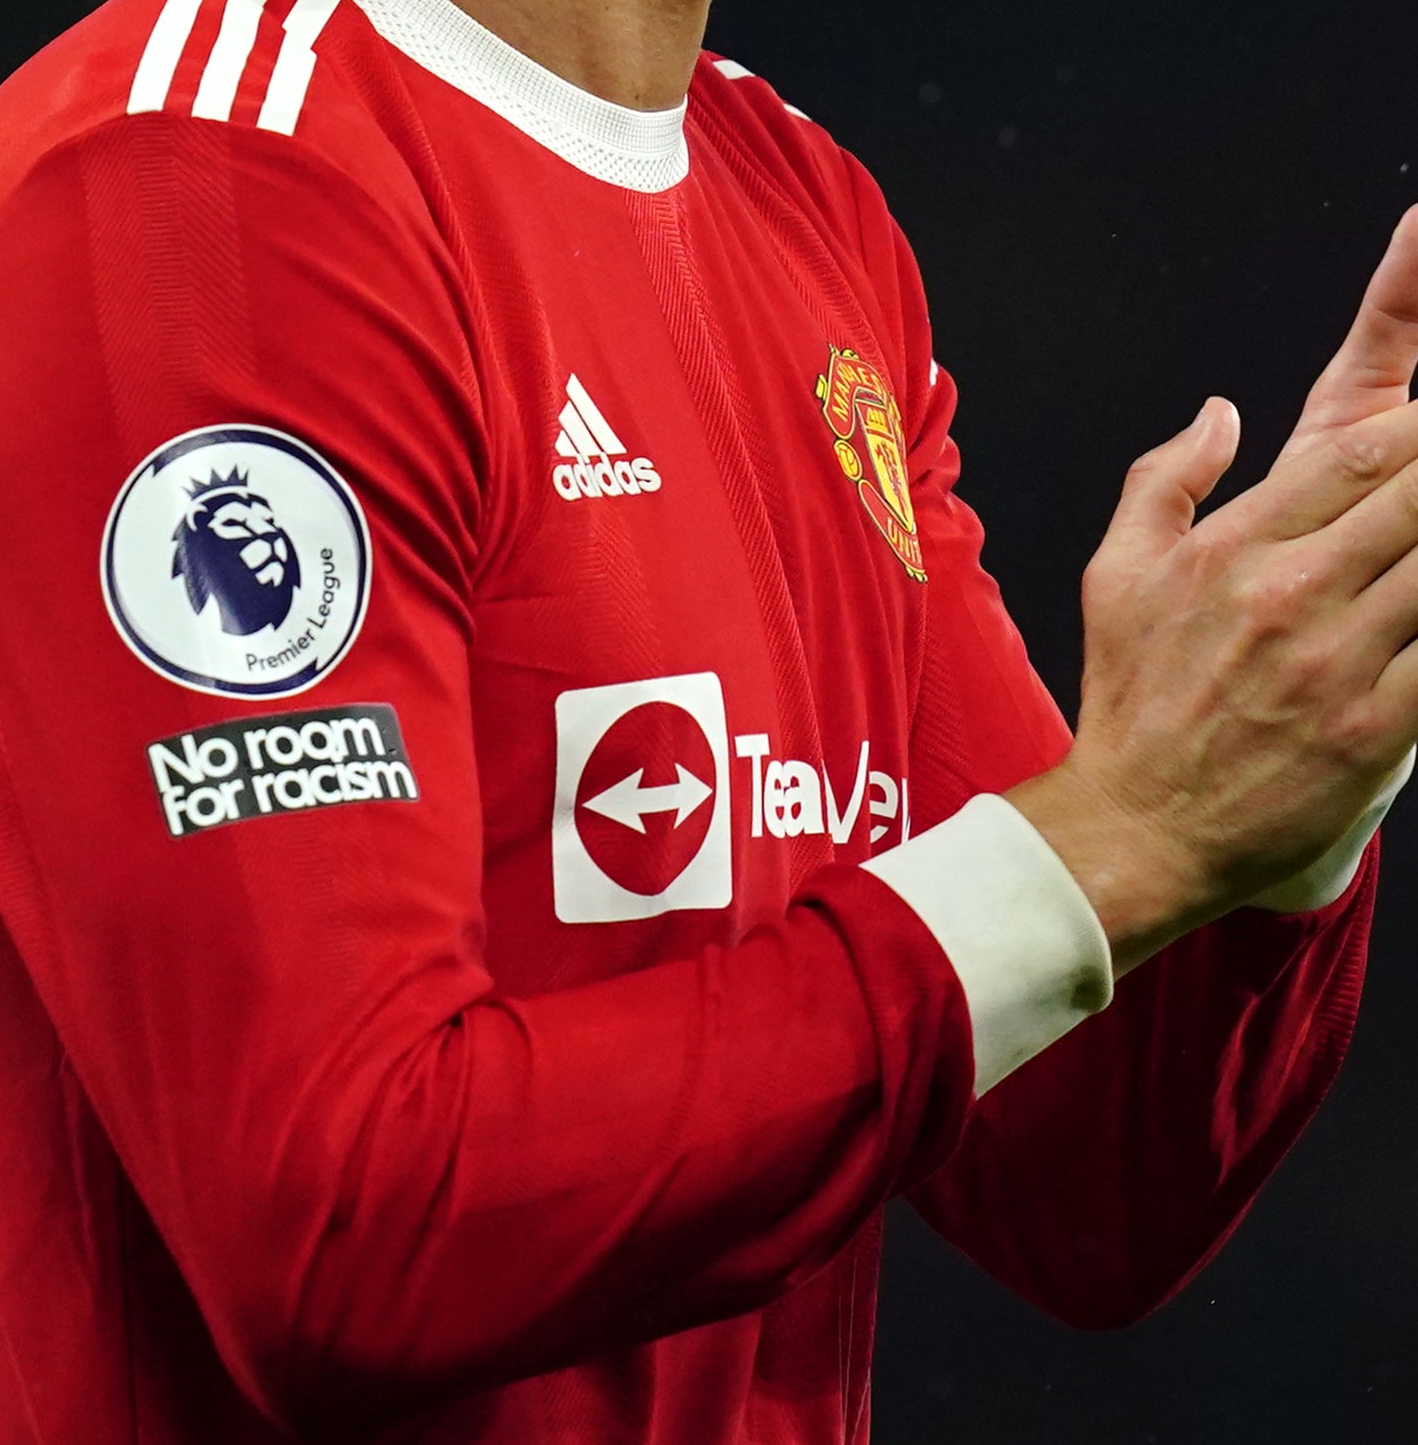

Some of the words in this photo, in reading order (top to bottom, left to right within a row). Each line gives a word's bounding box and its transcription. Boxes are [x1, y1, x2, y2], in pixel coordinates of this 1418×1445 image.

[552, 452, 662, 501] adidas
[245, 629, 316, 672] Premier
[308, 547, 341, 629] League
[148, 734, 239, 794] No
[244, 716, 386, 770] room
[163, 778, 245, 836] for
[252, 759, 419, 813] racism
